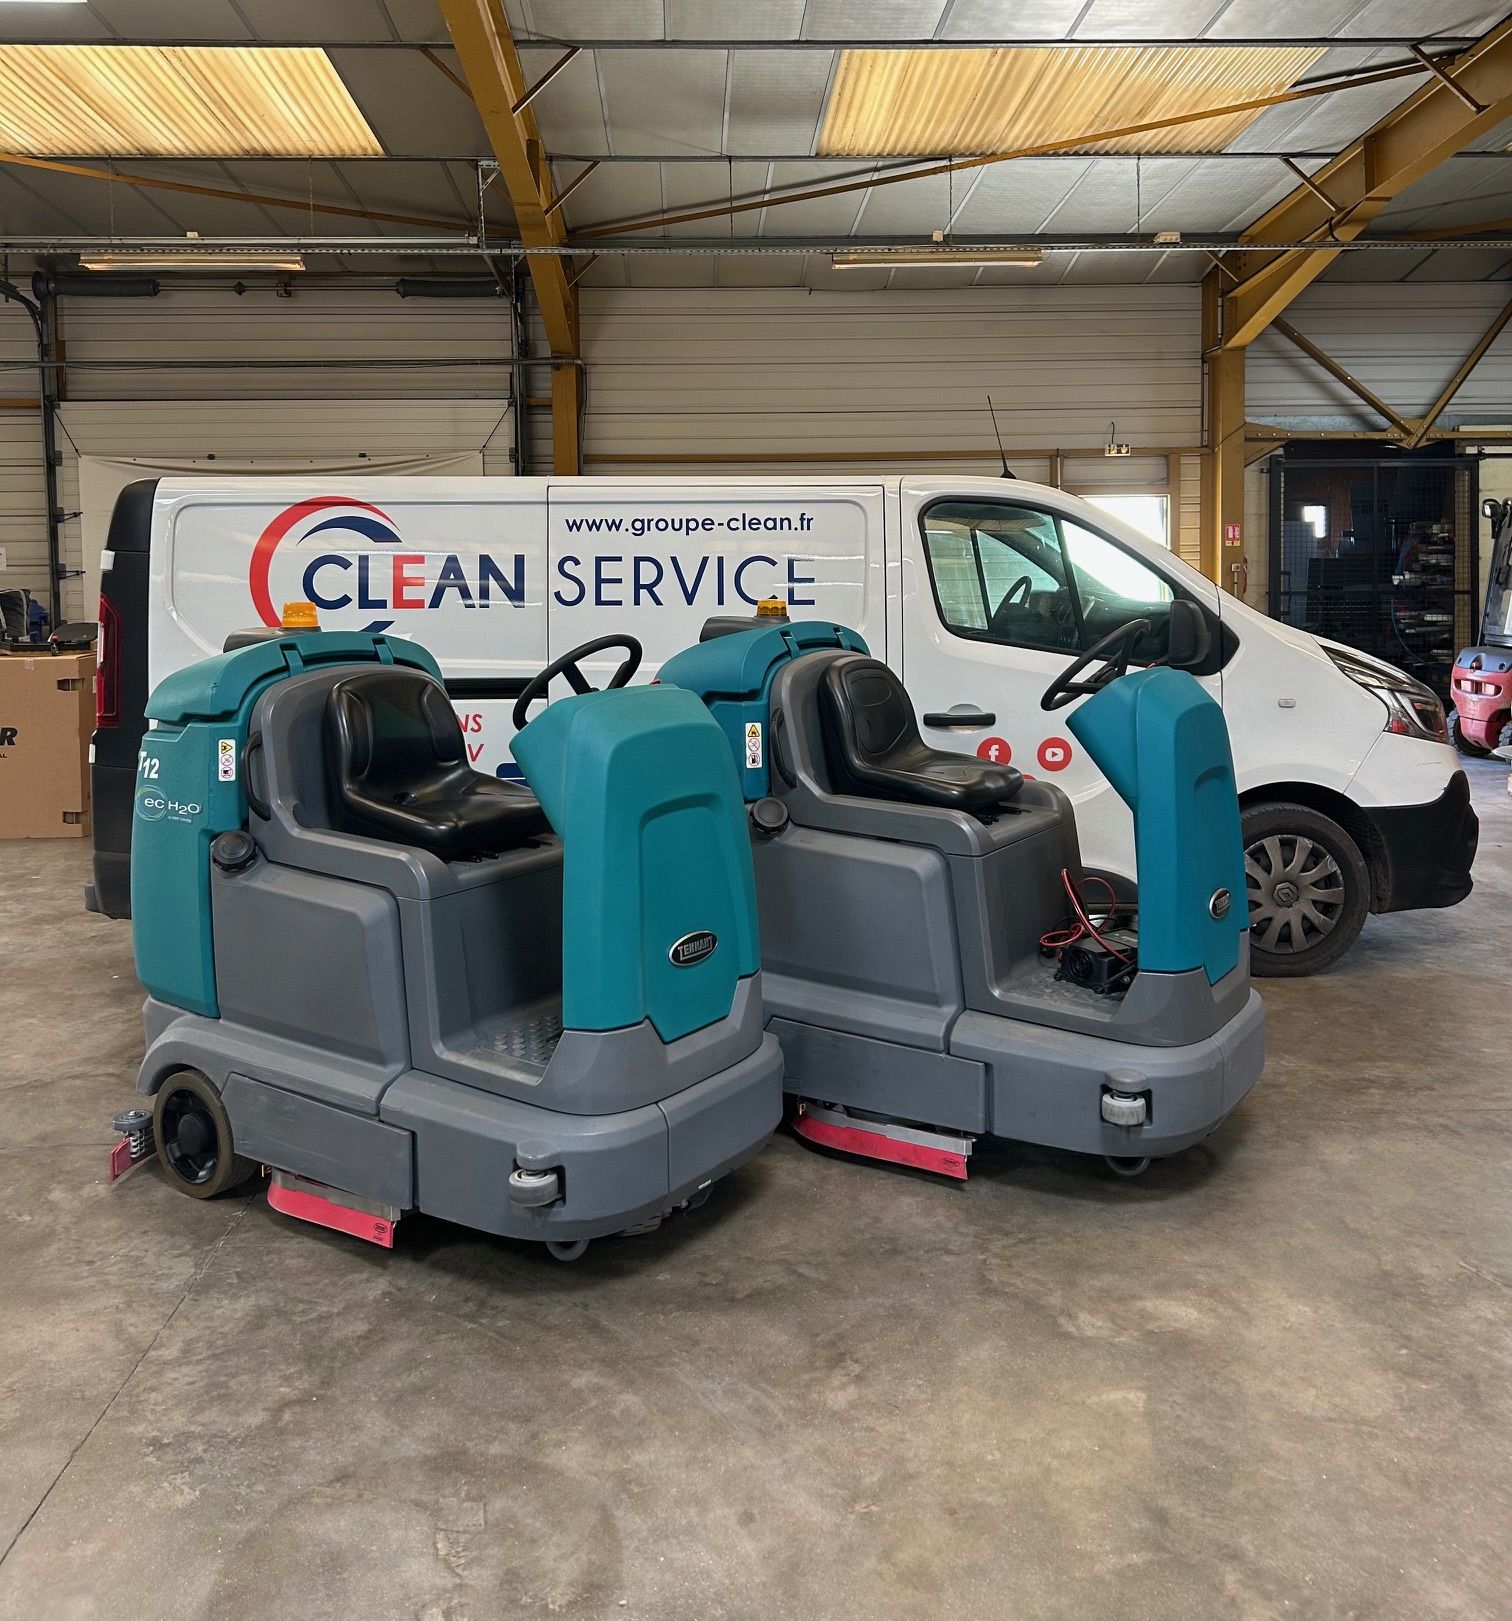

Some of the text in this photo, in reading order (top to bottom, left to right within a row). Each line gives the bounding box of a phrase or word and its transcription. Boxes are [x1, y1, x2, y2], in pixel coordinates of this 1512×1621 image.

[565, 513, 815, 536] www.groupe-clean.fr
[302, 554, 816, 610] CLEAN SERVICE
[138, 751, 160, 779] T12
